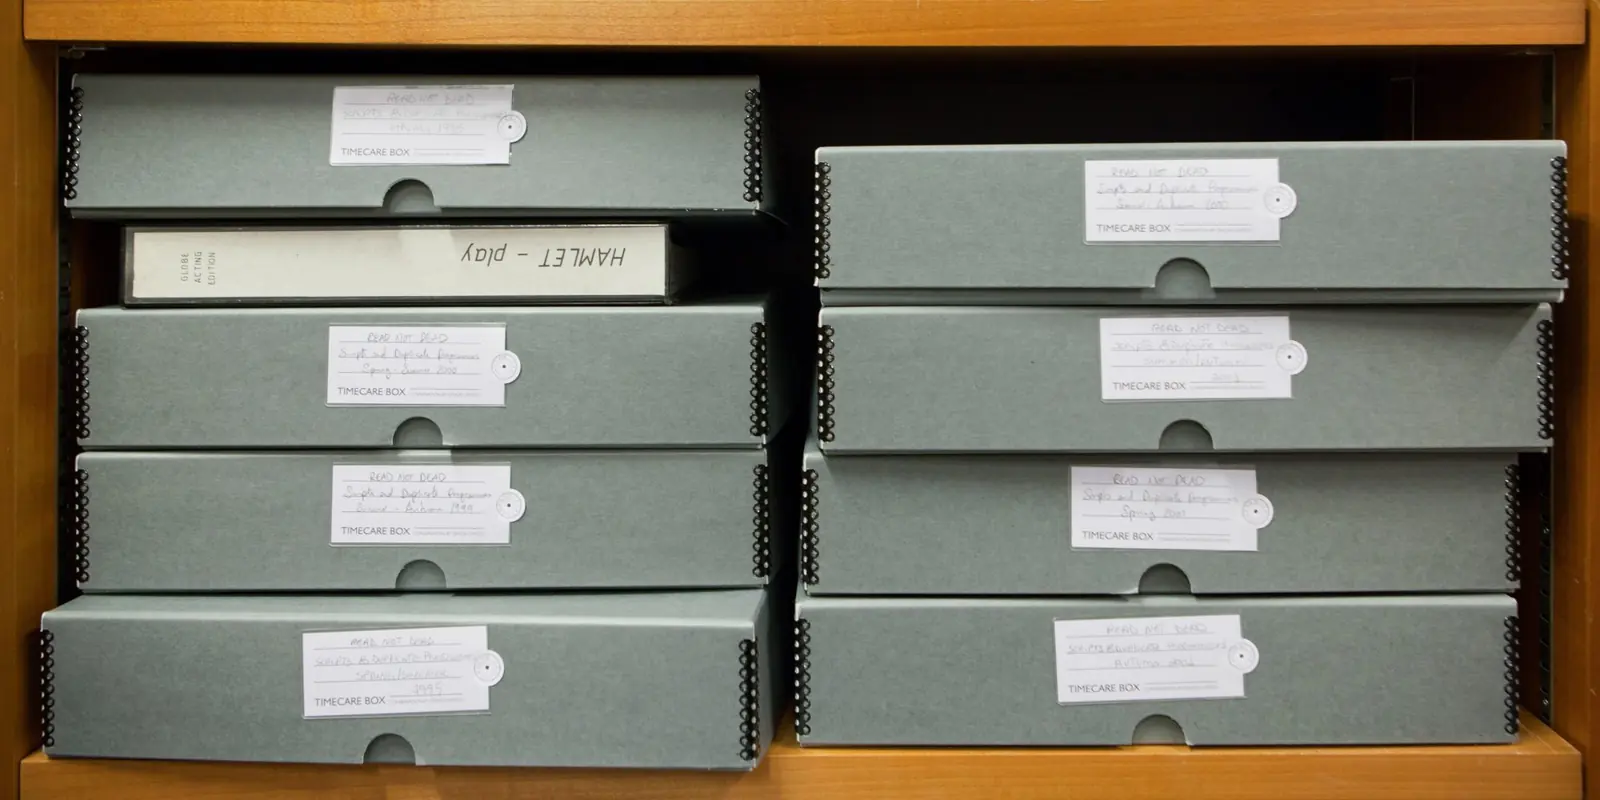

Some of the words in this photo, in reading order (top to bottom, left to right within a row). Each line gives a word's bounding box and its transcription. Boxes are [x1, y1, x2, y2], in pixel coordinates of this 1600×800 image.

[341, 147, 386, 157] TIMECARE
[389, 148, 410, 157] BOX
[1096, 223, 1147, 233] TIMECARE
[1149, 223, 1171, 233] BOX
[461, 243, 508, 267] play
[538, 247, 626, 267] HAMLET
[180, 253, 189, 281] GLOBE
[194, 251, 202, 284] ACTING
[207, 252, 216, 286] EDITION
[1112, 381, 1162, 391] TIMECARE
[1164, 381, 1187, 391] BOX
[337, 387, 384, 397] TIMECARE
[385, 387, 406, 396] BOX
[341, 526, 388, 536] TIMECARE
[389, 526, 411, 536] BOX
[1081, 530, 1130, 541] TIMECARE
[1133, 531, 1154, 541] BOX
[1068, 683, 1117, 694] TIMECARE
[1119, 683, 1141, 693] BOX
[314, 697, 363, 708] TIMECARE
[364, 696, 386, 706] BOX
